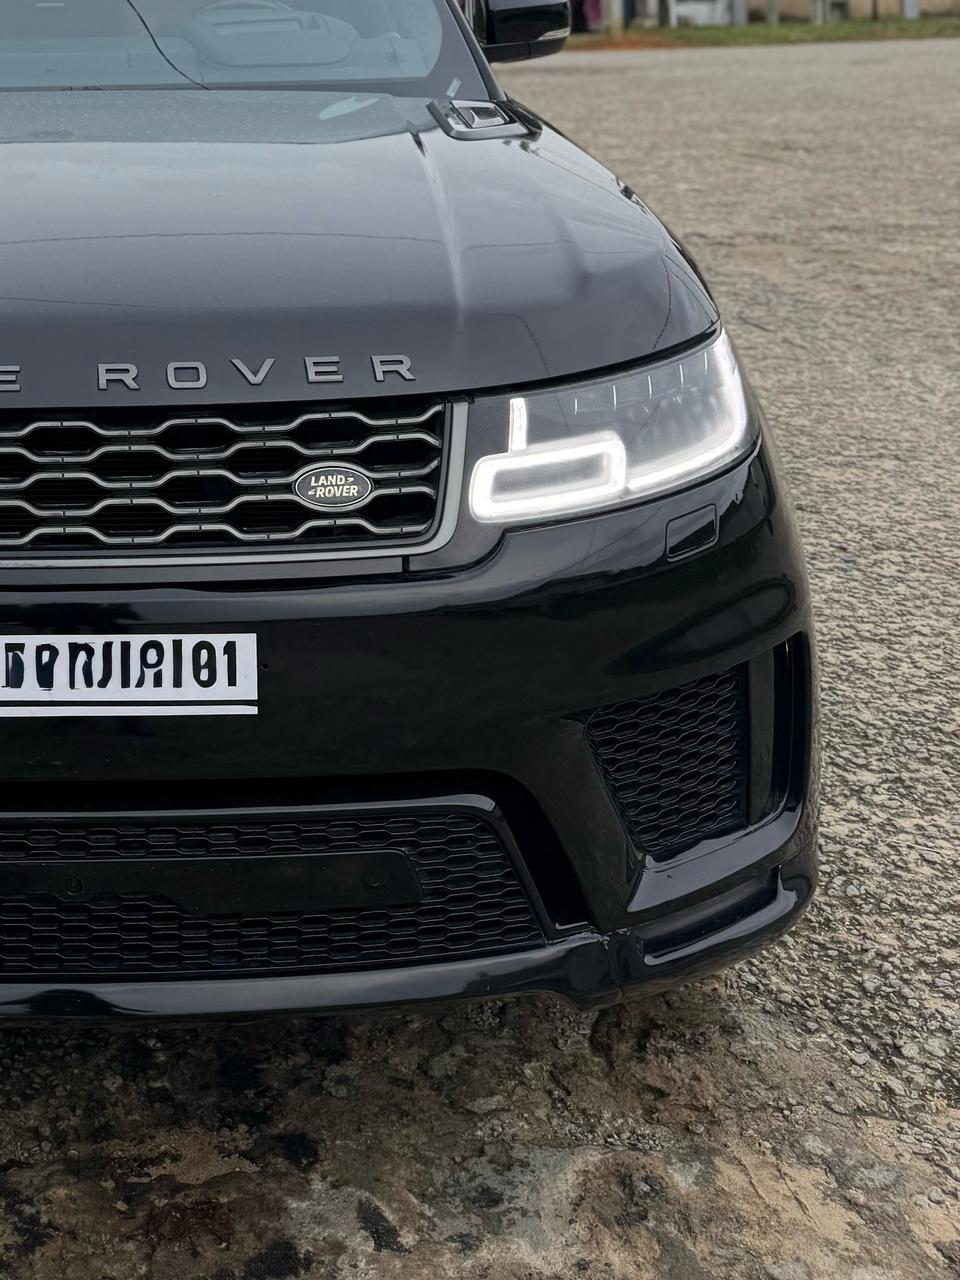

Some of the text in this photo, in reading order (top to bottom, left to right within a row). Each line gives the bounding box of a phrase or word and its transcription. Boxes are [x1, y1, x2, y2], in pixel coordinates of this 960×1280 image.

[97, 354, 416, 390] ROVER
[310, 474, 346, 486] LAND
[315, 485, 359, 498] ROVER
